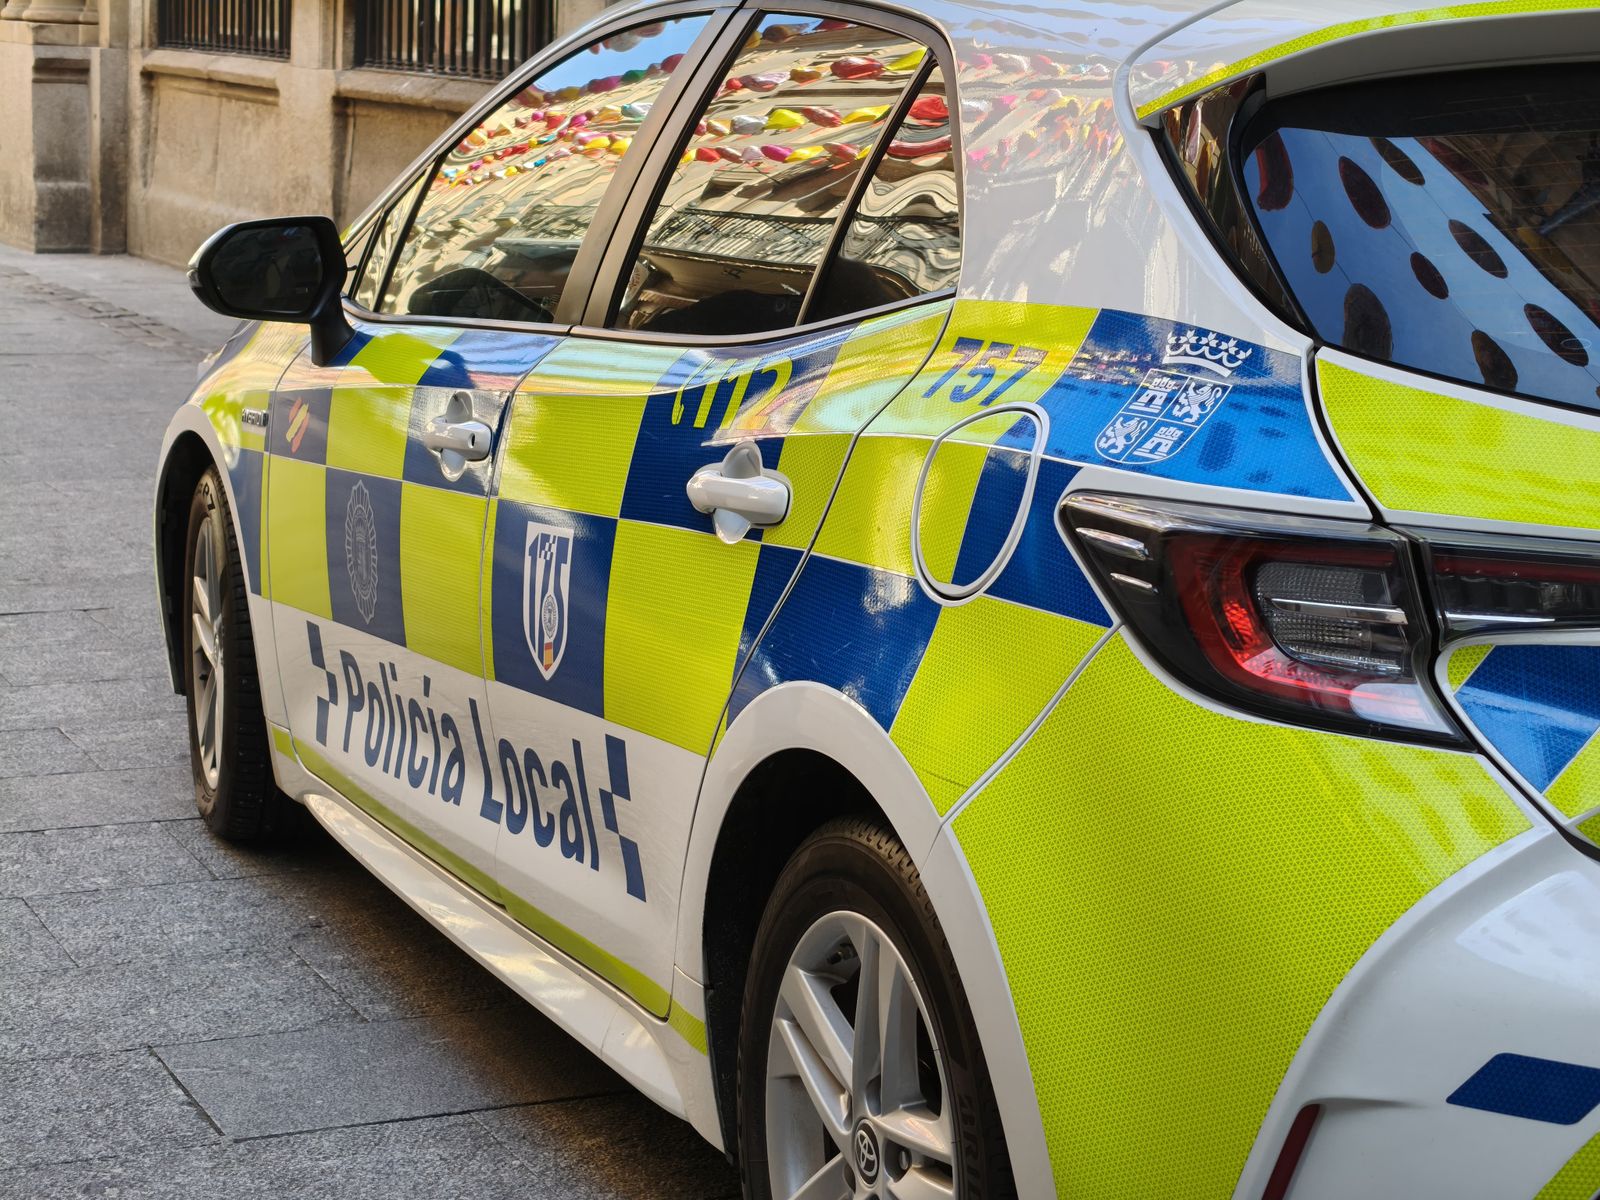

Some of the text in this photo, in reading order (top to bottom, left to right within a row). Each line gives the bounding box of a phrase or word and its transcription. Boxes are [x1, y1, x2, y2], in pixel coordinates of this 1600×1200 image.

[693, 357, 793, 430] 112
[922, 336, 1049, 407] 757
[340, 649, 600, 872] Policía Local
